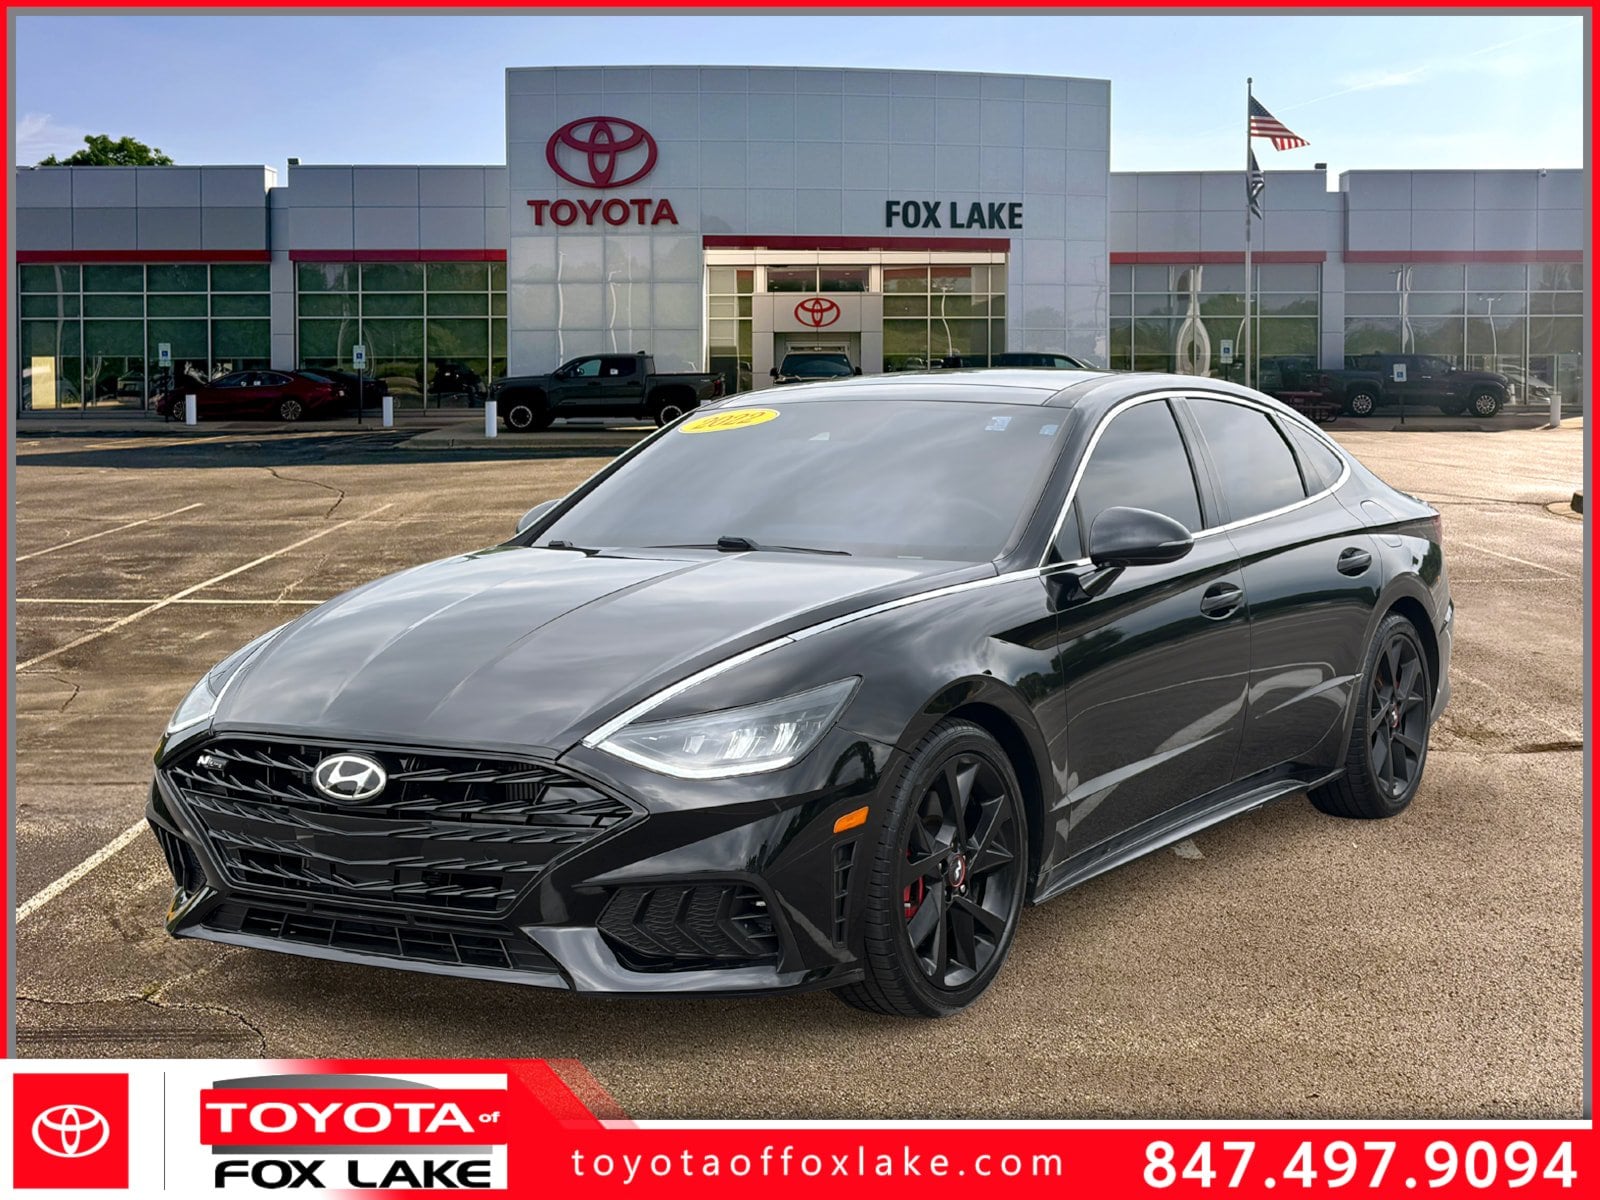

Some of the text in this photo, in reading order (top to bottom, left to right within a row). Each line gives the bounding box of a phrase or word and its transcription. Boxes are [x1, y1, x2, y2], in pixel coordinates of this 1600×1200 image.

[527, 198, 679, 226] TOYOTA
[885, 200, 1023, 230] FOX LAKE
[692, 411, 766, 430] 2022
